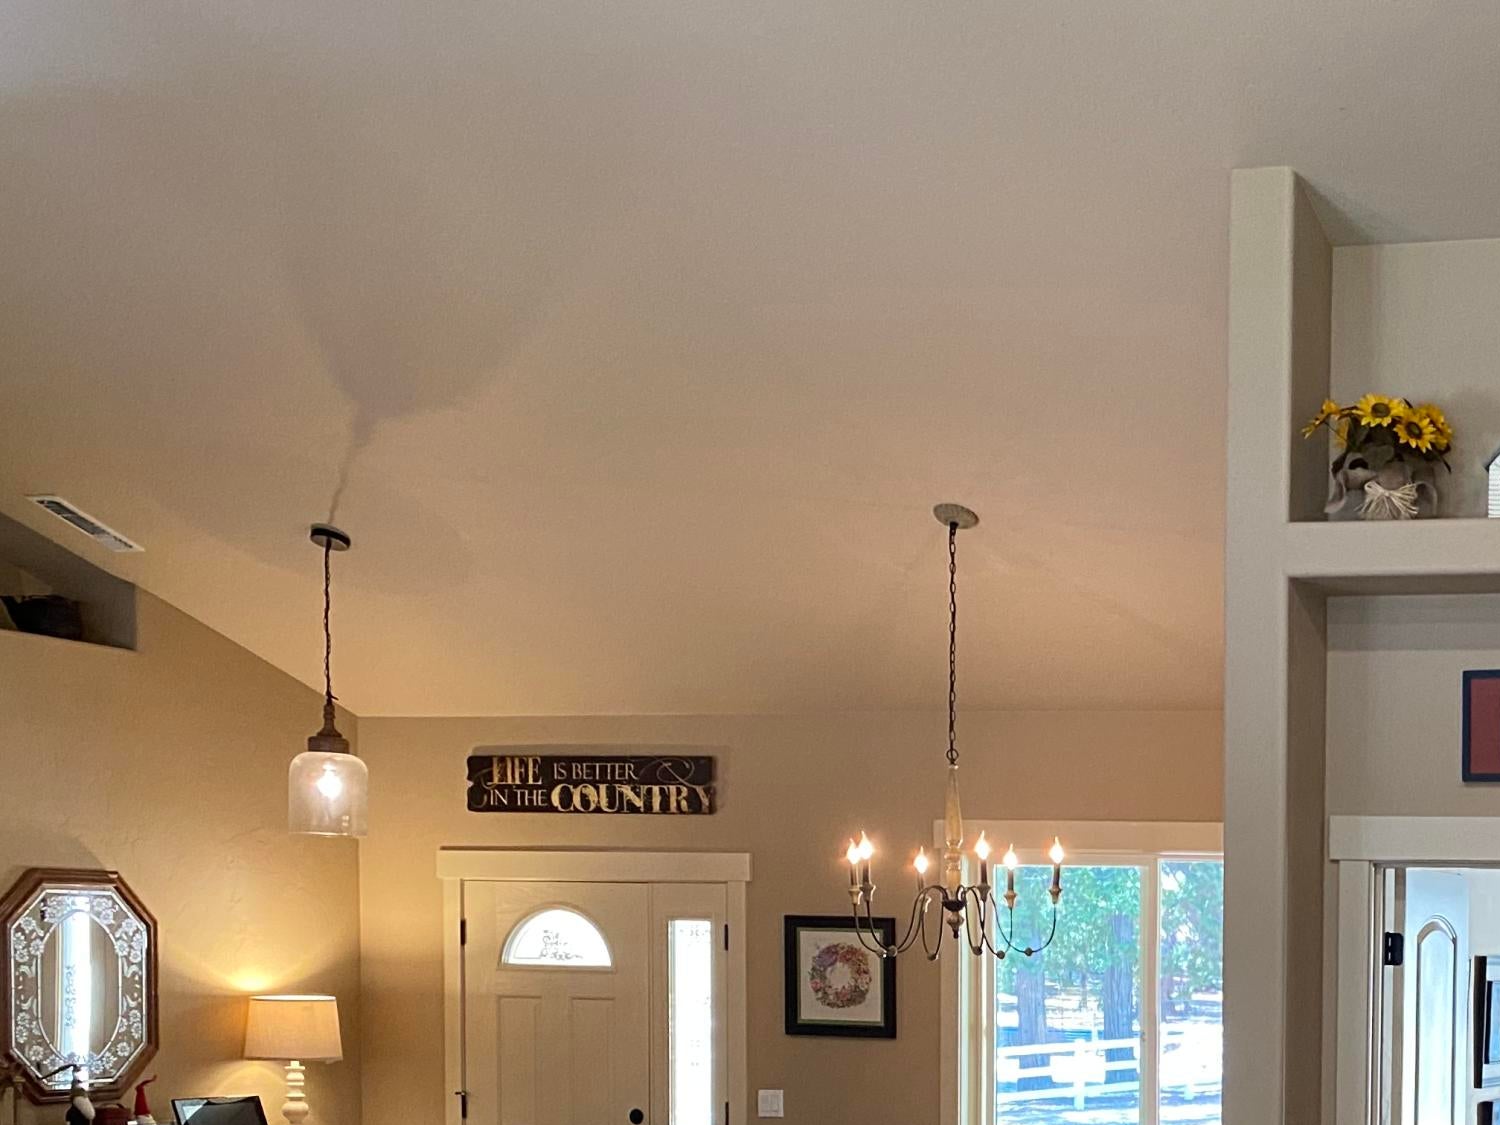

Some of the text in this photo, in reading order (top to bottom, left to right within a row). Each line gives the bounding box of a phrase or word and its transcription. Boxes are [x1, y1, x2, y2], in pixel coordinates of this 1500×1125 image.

[486, 756, 639, 785] LIFE IS BETTER
[490, 783, 714, 813] IN THE COUNTRY
